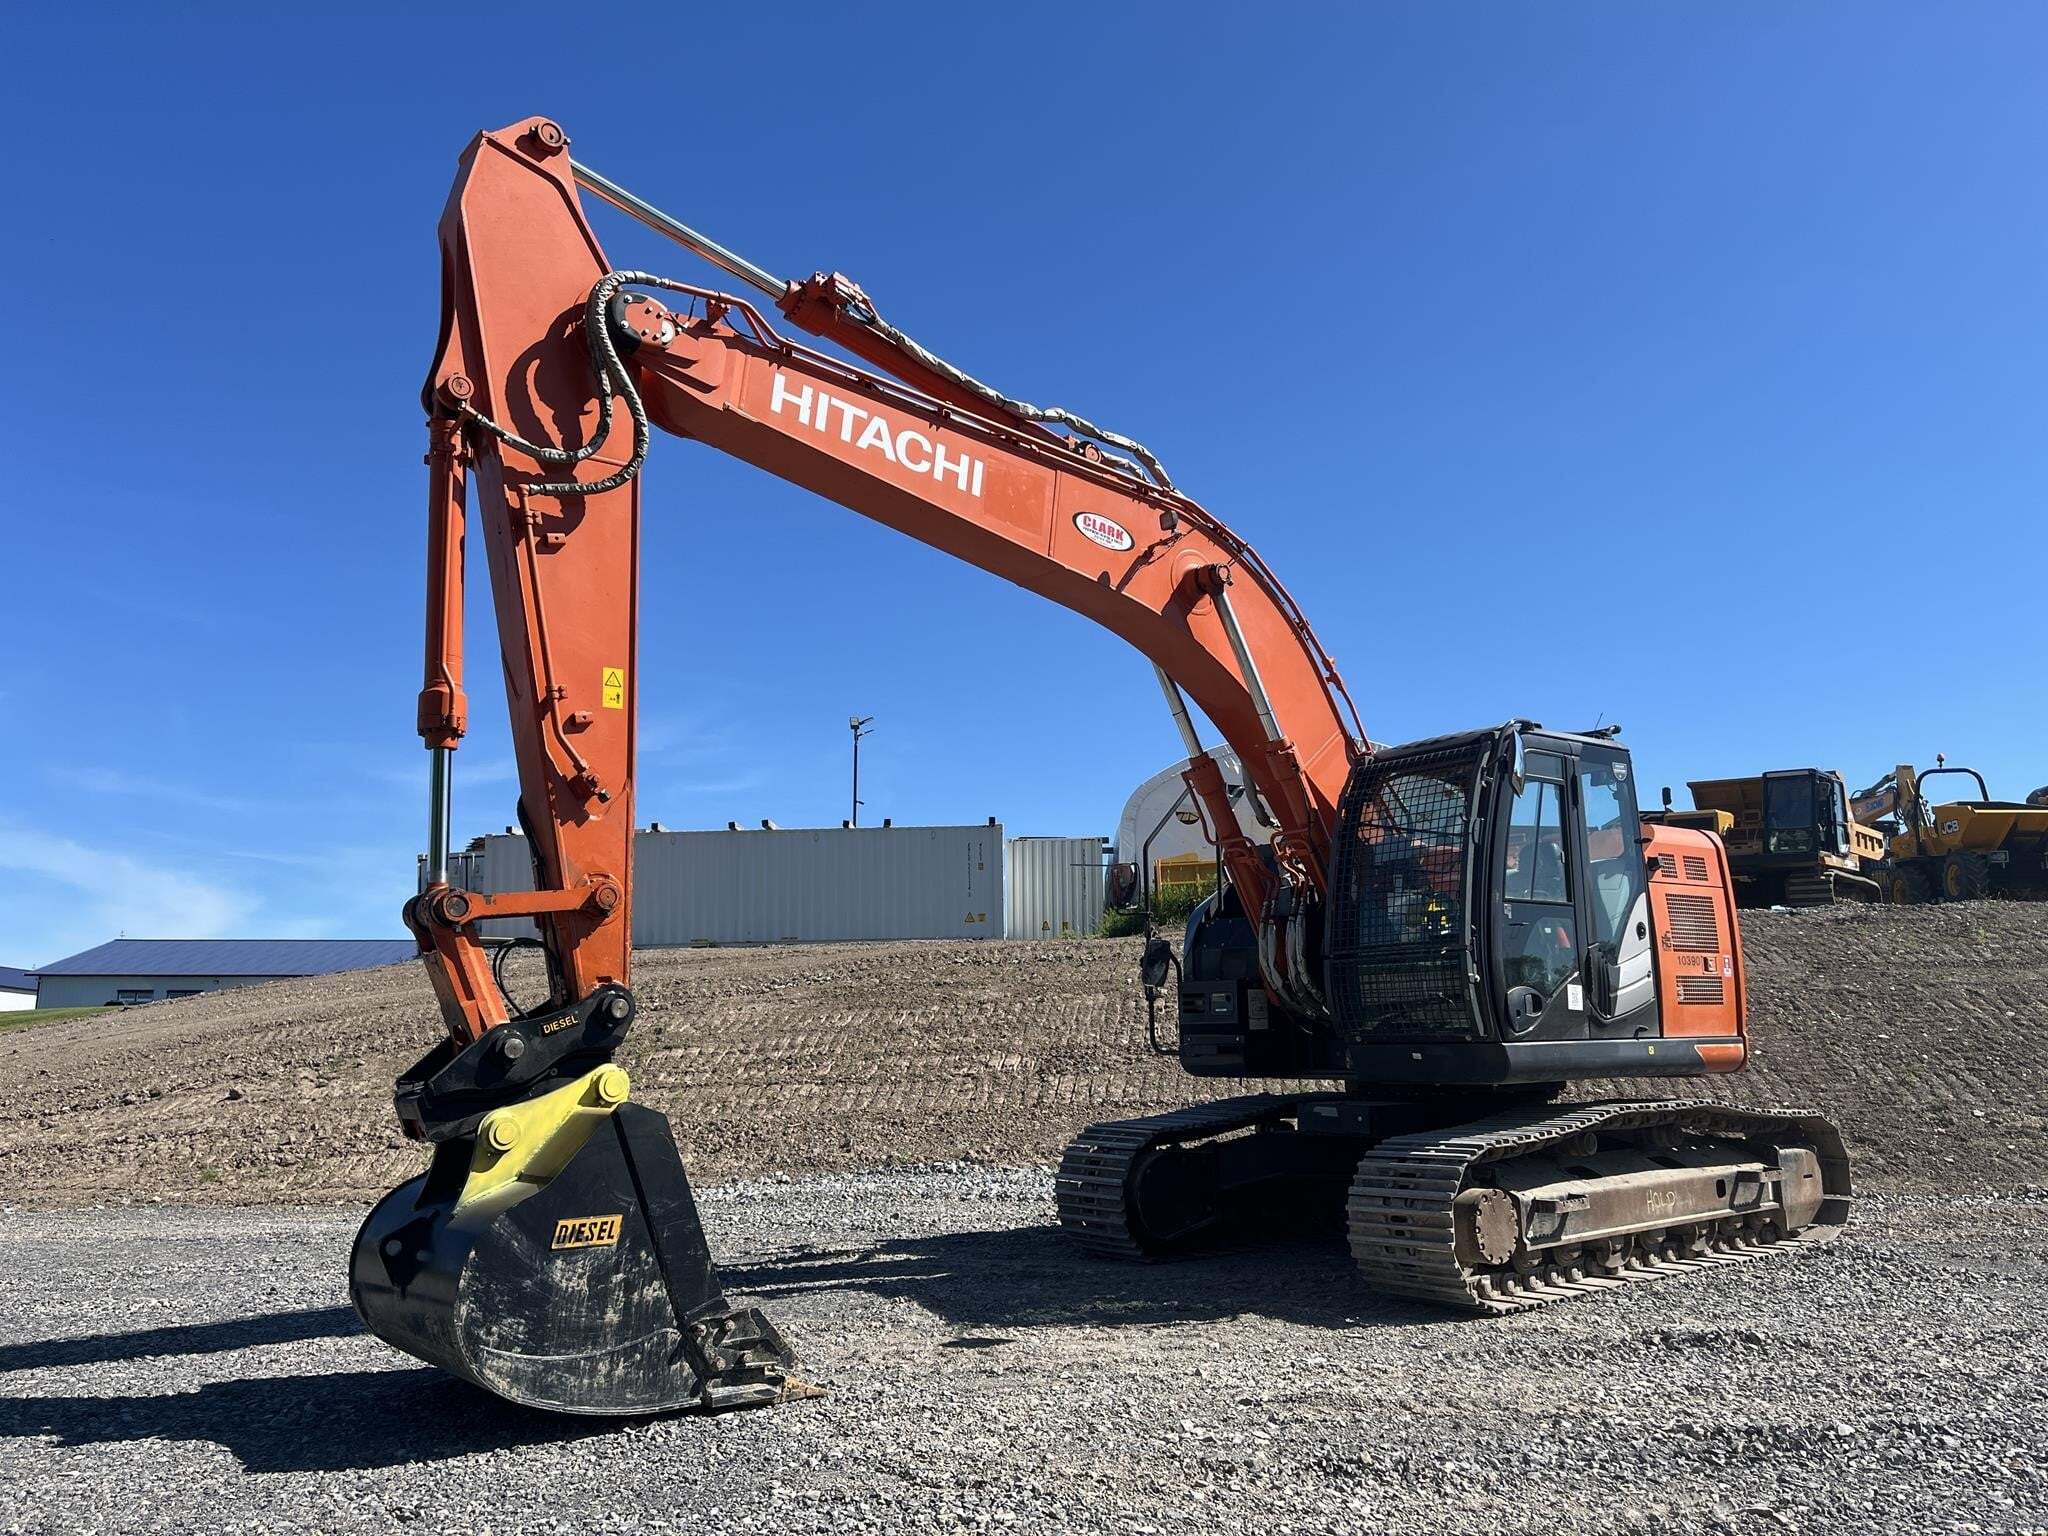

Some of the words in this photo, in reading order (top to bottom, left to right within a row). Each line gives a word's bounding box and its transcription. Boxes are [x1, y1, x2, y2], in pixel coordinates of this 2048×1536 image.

[770, 372, 985, 498] HITACHI
[1082, 515, 1124, 541] CLARK
[1942, 819, 1960, 835] JCB
[543, 1015, 578, 1034] DIESEL
[1646, 1189, 1676, 1214] HOLD
[556, 1220, 615, 1245] DIESEL
